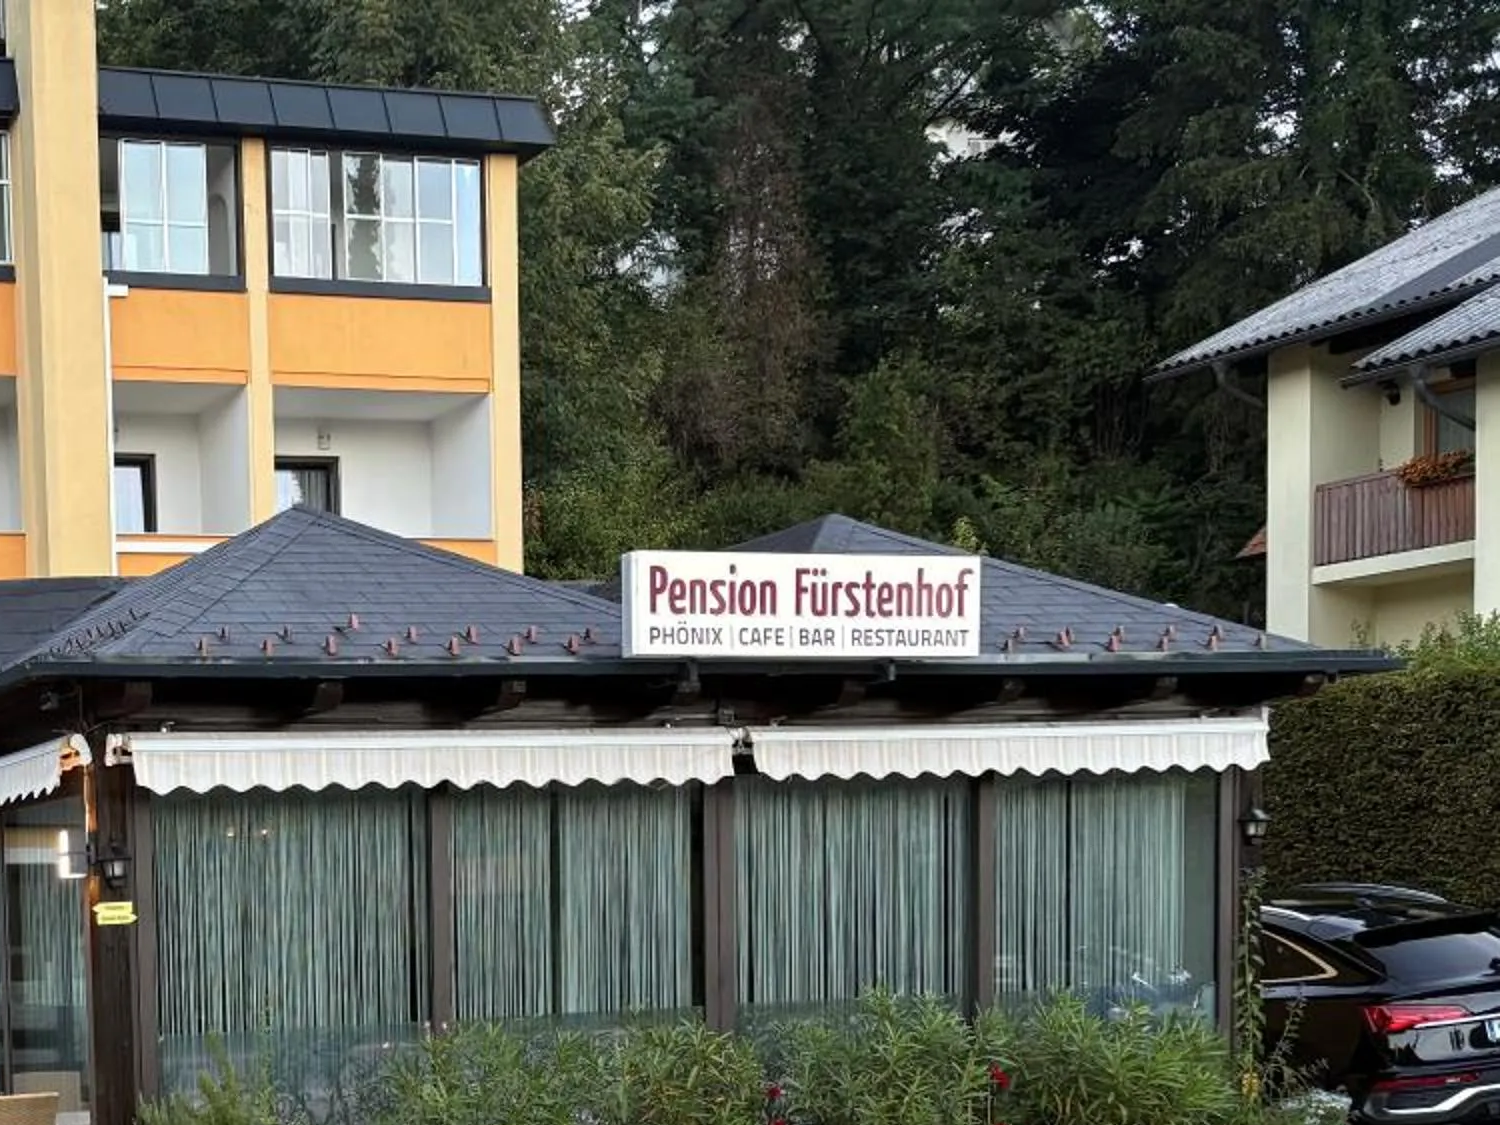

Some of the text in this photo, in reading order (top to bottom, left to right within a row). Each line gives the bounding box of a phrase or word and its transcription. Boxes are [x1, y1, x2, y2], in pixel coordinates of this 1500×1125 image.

[649, 564, 975, 618] Pension Fürstenhof
[649, 621, 970, 648] PHÖNIX CAFE BAR RESTAURANT
